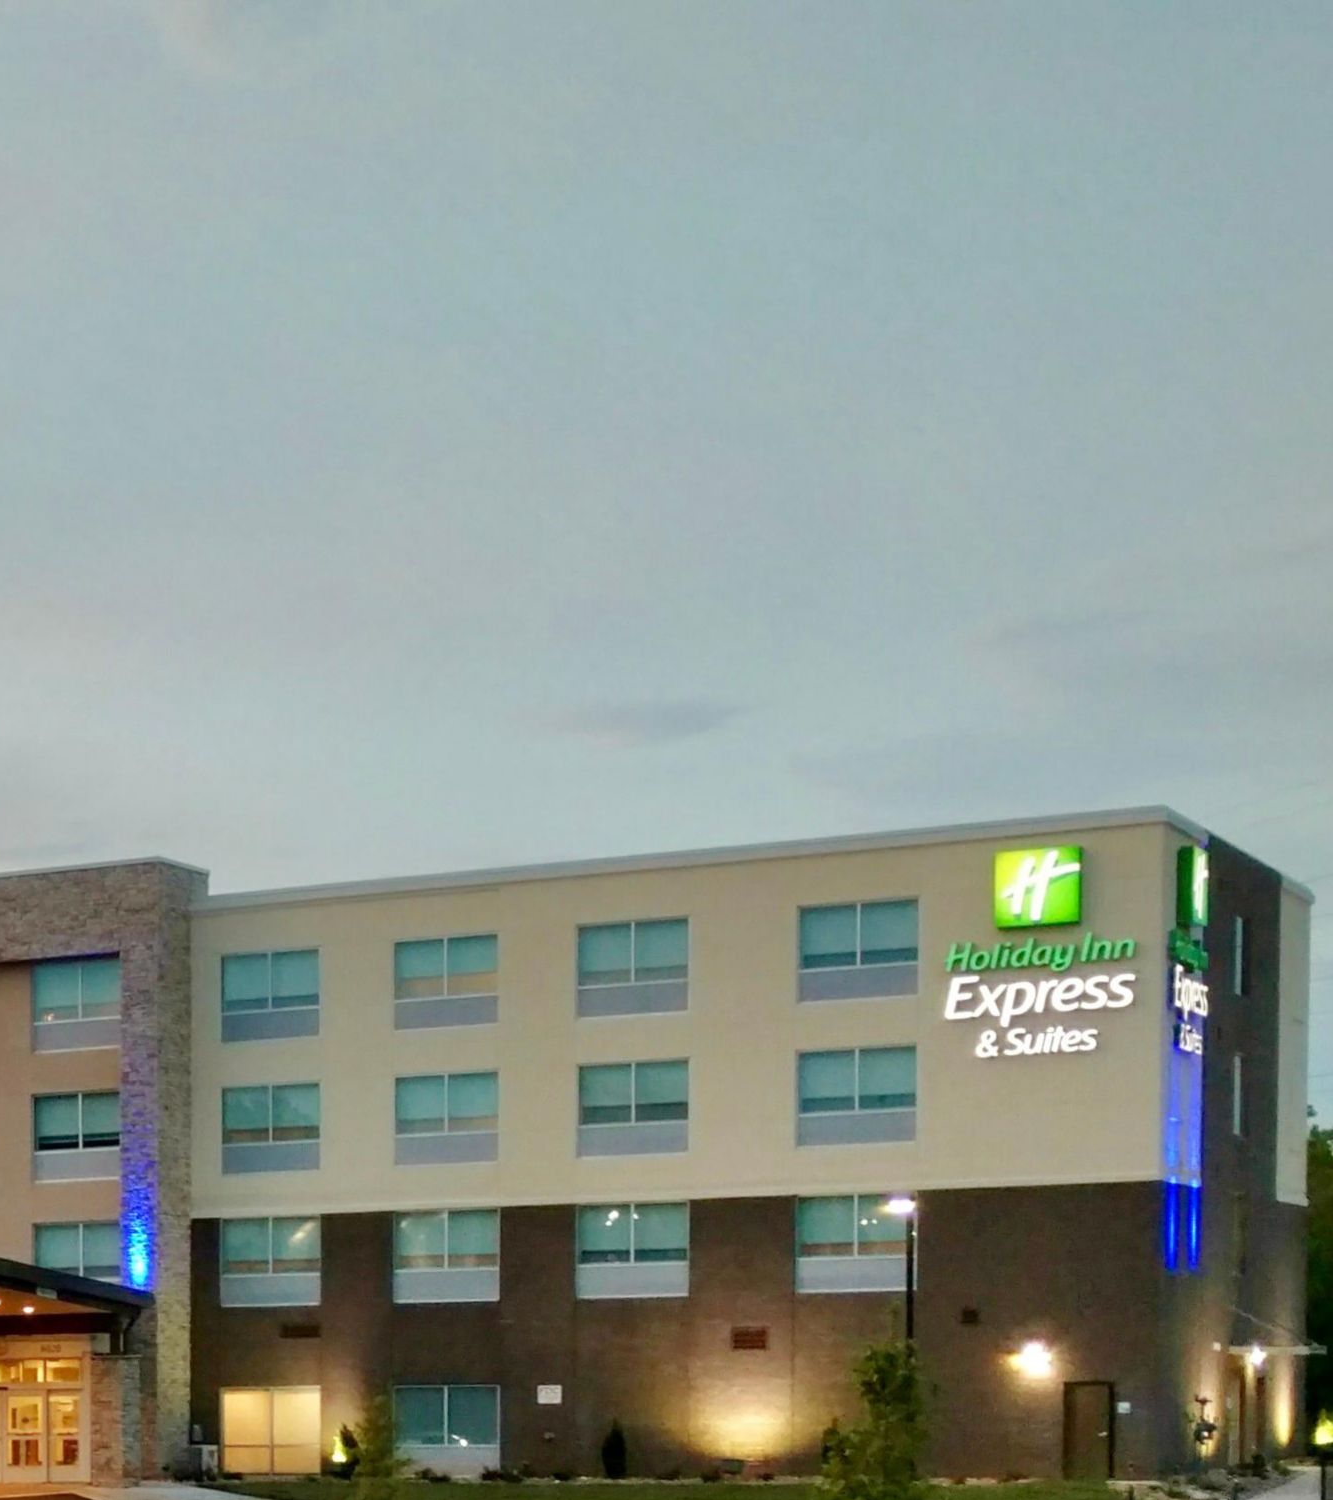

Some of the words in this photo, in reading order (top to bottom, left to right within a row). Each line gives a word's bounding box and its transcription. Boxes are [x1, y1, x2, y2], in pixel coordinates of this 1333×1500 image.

[944, 937, 1076, 972] Holiday
[1080, 931, 1136, 963] Inn
[943, 973, 1137, 1028] Express
[1175, 963, 1209, 1021] Epress
[974, 1029, 1000, 1058] &
[1003, 1024, 1099, 1056] Suites
